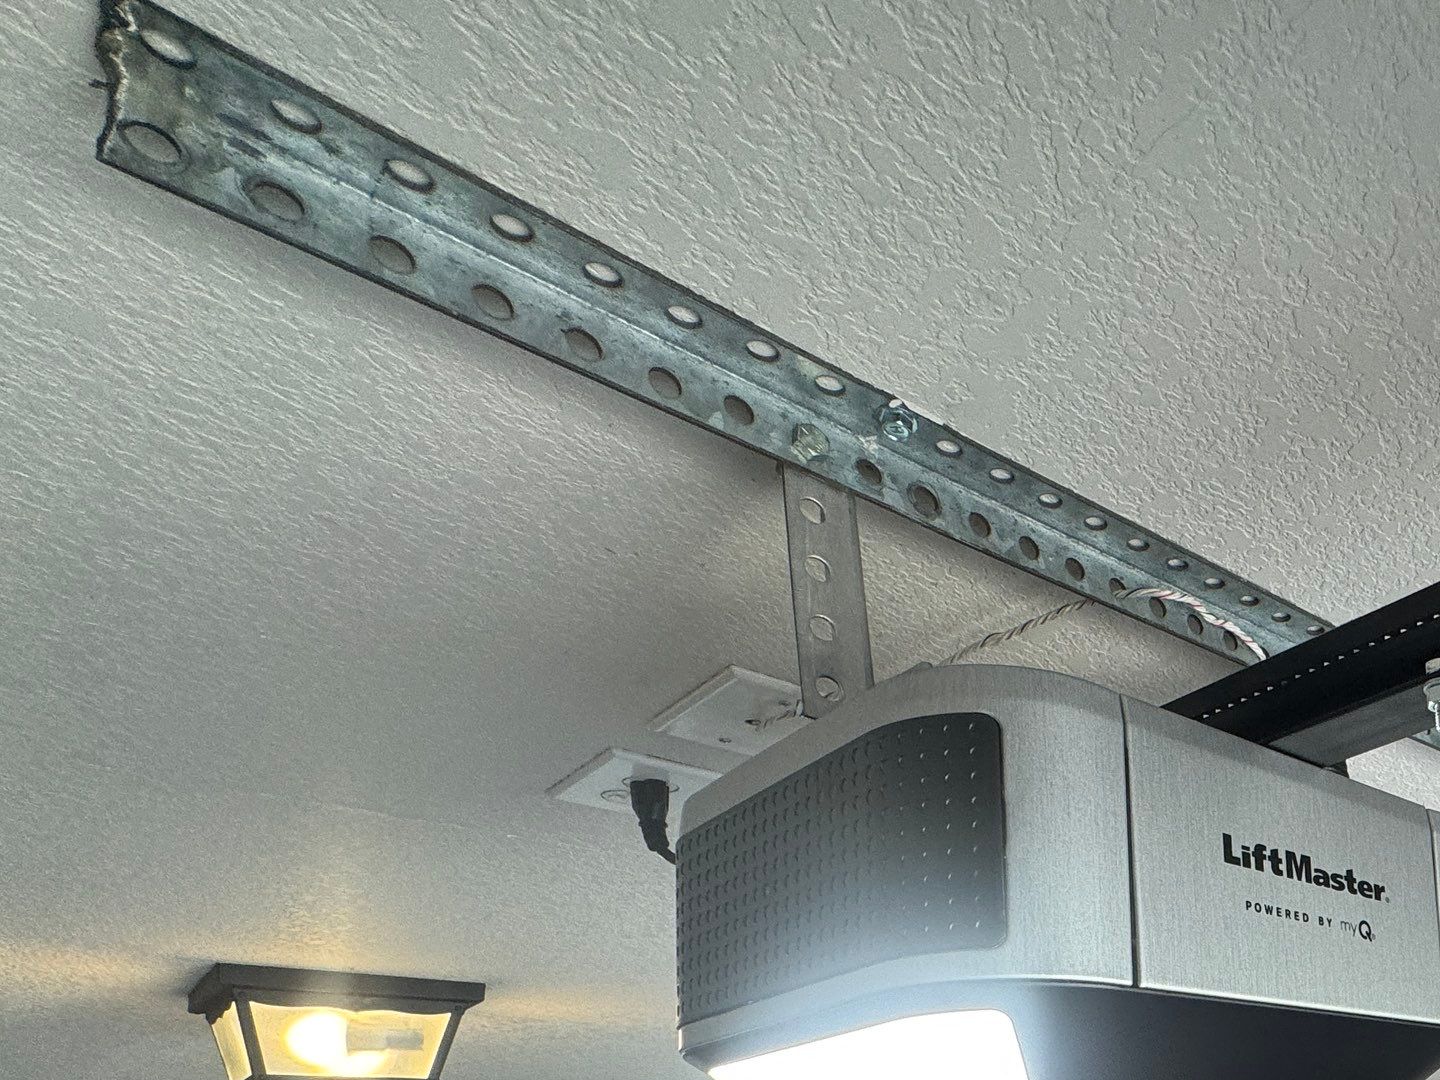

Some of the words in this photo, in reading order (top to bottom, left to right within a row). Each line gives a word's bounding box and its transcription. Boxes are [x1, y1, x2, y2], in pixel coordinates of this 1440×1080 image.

[1222, 833, 1385, 901] LiftMaster
[1245, 901, 1309, 923] POWERED
[1318, 916, 1333, 928] BY
[1340, 920, 1372, 942] myQ
